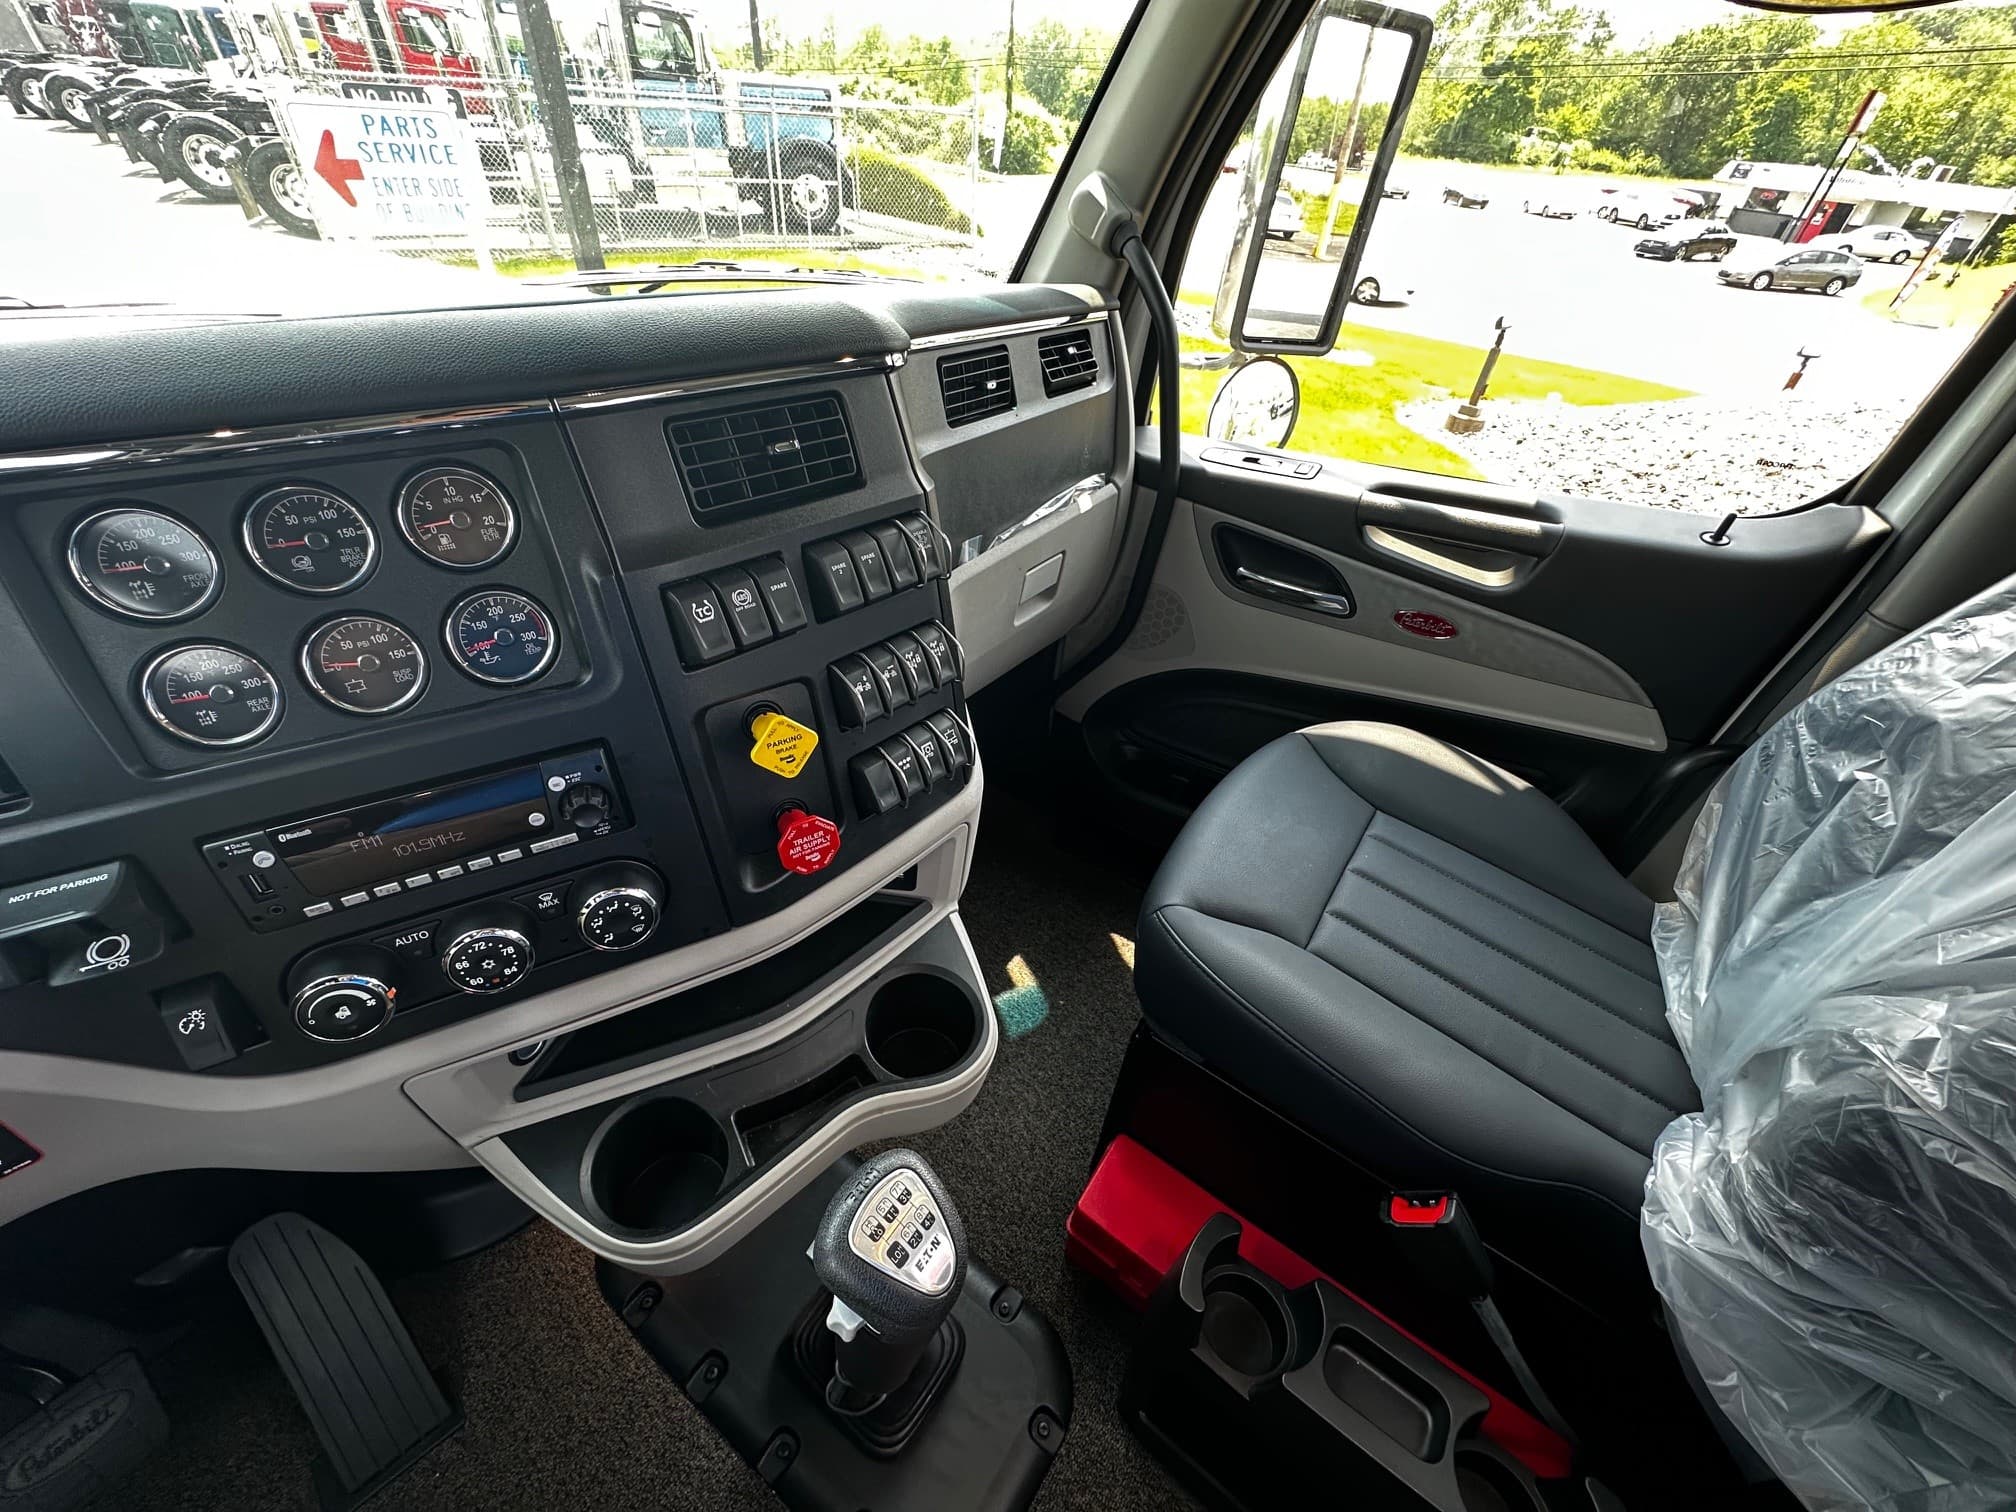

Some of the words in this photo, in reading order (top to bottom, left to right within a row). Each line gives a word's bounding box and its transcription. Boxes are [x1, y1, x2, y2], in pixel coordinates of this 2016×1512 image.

[361, 114, 438, 139] PARTS
[358, 141, 458, 165] SERVICE
[372, 177, 423, 197] ENTER
[428, 177, 464, 198] SIDE
[444, 486, 456, 496] 10
[470, 494, 482, 503] 15
[425, 501, 433, 510] 5
[285, 514, 299, 526] 50
[303, 516, 318, 525] PSI
[318, 508, 338, 520] 100
[482, 515, 495, 526] 20
[132, 527, 156, 540] 200
[337, 527, 356, 539] 150
[158, 533, 181, 546] 250
[116, 540, 138, 552] 150
[178, 550, 201, 562] 300
[860, 552, 876, 562] SPARE
[831, 562, 847, 572] SPARE
[770, 581, 788, 592] SPARE
[487, 605, 504, 617] 200
[695, 605, 712, 618] TC
[509, 612, 526, 623] 250
[470, 620, 488, 631] 150
[370, 633, 389, 645] 100
[520, 630, 537, 642] 300
[340, 639, 353, 650] 50
[357, 641, 370, 649] PSI
[388, 648, 406, 660] 150
[199, 659, 220, 671] 200
[222, 664, 243, 675] 250
[183, 671, 203, 683] 150
[241, 677, 261, 689] 300
[394, 673, 415, 683] LOAD
[246, 697, 269, 707] REAR
[251, 703, 273, 713] AXLE
[766, 733, 803, 749] PARKING
[775, 744, 798, 755] BRAKE
[350, 834, 384, 852] FM1
[392, 831, 467, 857] 101.9MHz
[792, 830, 825, 846] TRAILER
[789, 846, 802, 857] AIR
[803, 834, 831, 850] SUPPLY
[8, 891, 34, 904] NOT
[33, 885, 59, 897] FOR
[59, 873, 109, 892] PARKING
[538, 897, 561, 910] MAX
[395, 930, 430, 948] AUTO
[472, 941, 487, 952] 72
[501, 946, 515, 957] 78
[455, 960, 470, 970] 66
[503, 965, 518, 976] 84
[469, 976, 485, 986] 60
[900, 1194, 907, 1202] 3
[878, 1205, 886, 1214] 5
[913, 1237, 920, 1246] 2
[891, 1250, 902, 1264] LO
